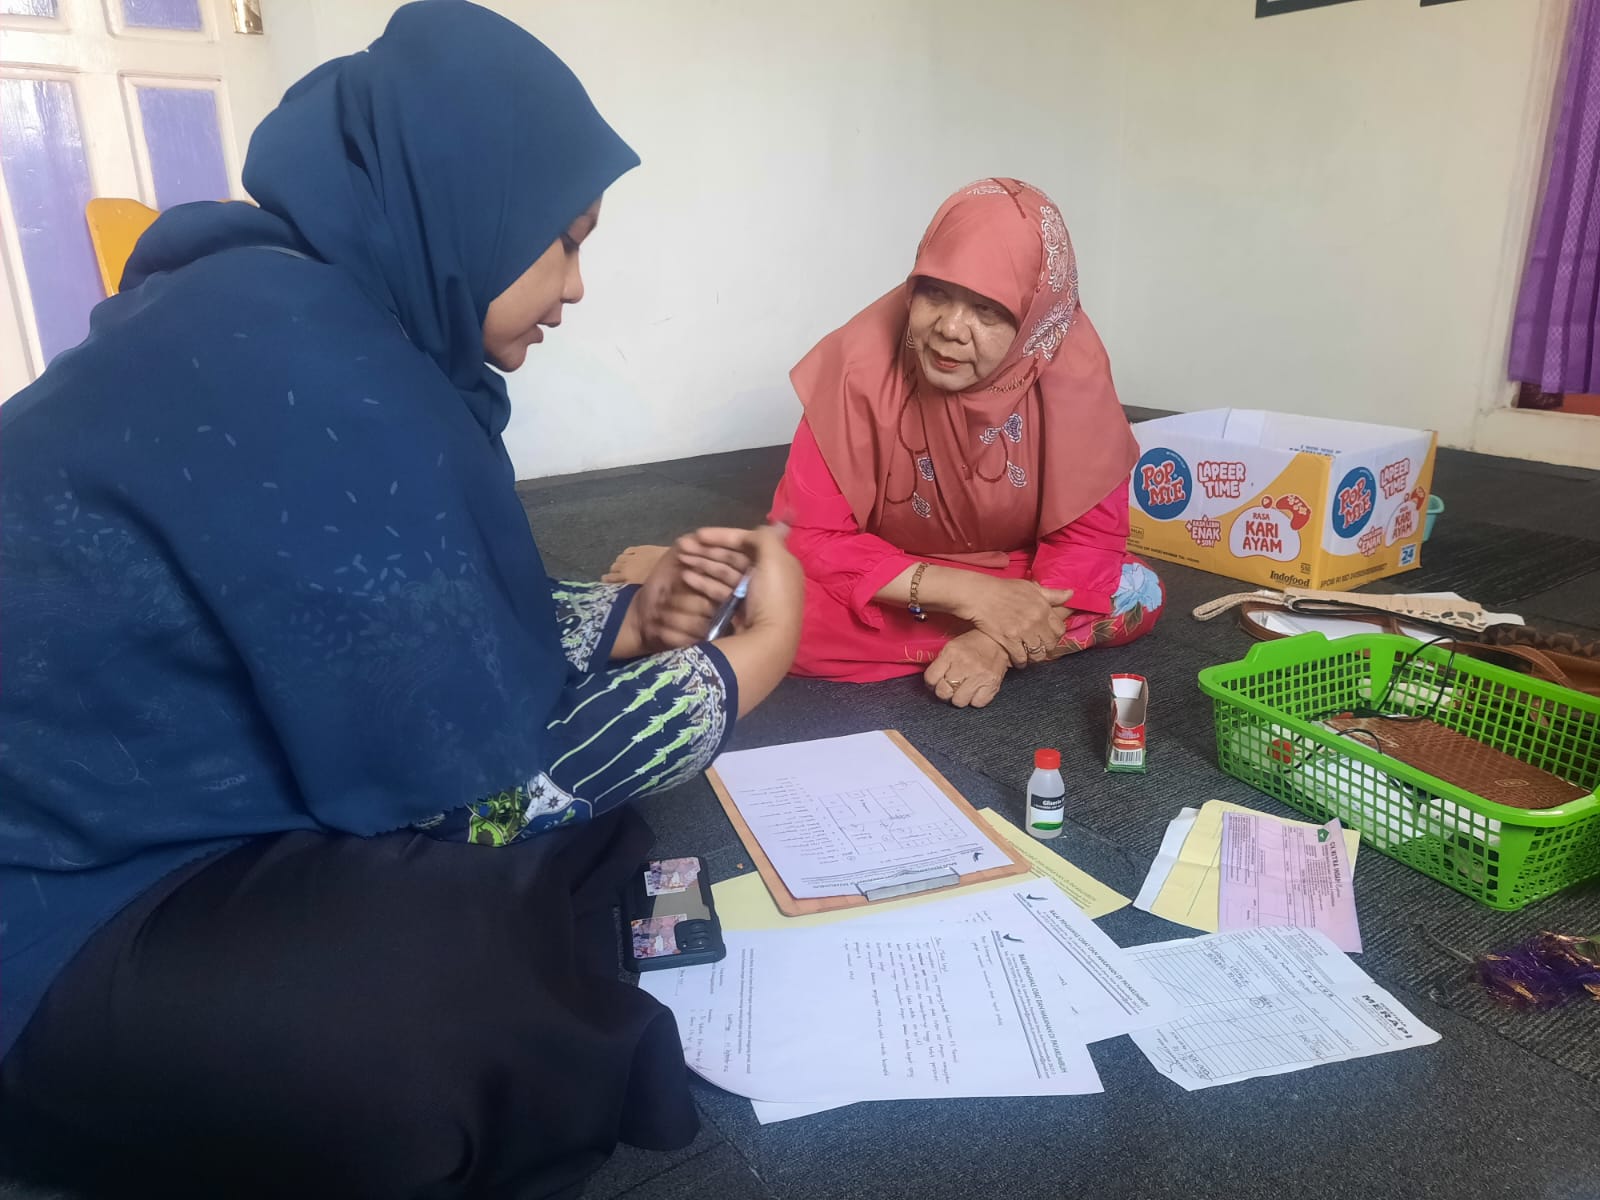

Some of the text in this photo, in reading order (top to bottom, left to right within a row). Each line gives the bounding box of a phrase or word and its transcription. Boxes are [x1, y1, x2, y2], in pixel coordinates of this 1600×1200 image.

[1142, 461, 1175, 490] POP
[1198, 461, 1246, 482] LAPEER
[1149, 477, 1186, 506] MIE
[1203, 479, 1241, 499] TIME
[1339, 478, 1366, 515] POP
[1383, 476, 1407, 500] TIME
[1192, 527, 1221, 540] ENAK
[1245, 521, 1279, 538] KARI
[1243, 537, 1282, 553] AYAM
[1401, 548, 1414, 561] 24
[1270, 570, 1310, 587] Indofood
[1361, 994, 1414, 1040] MERAPI
